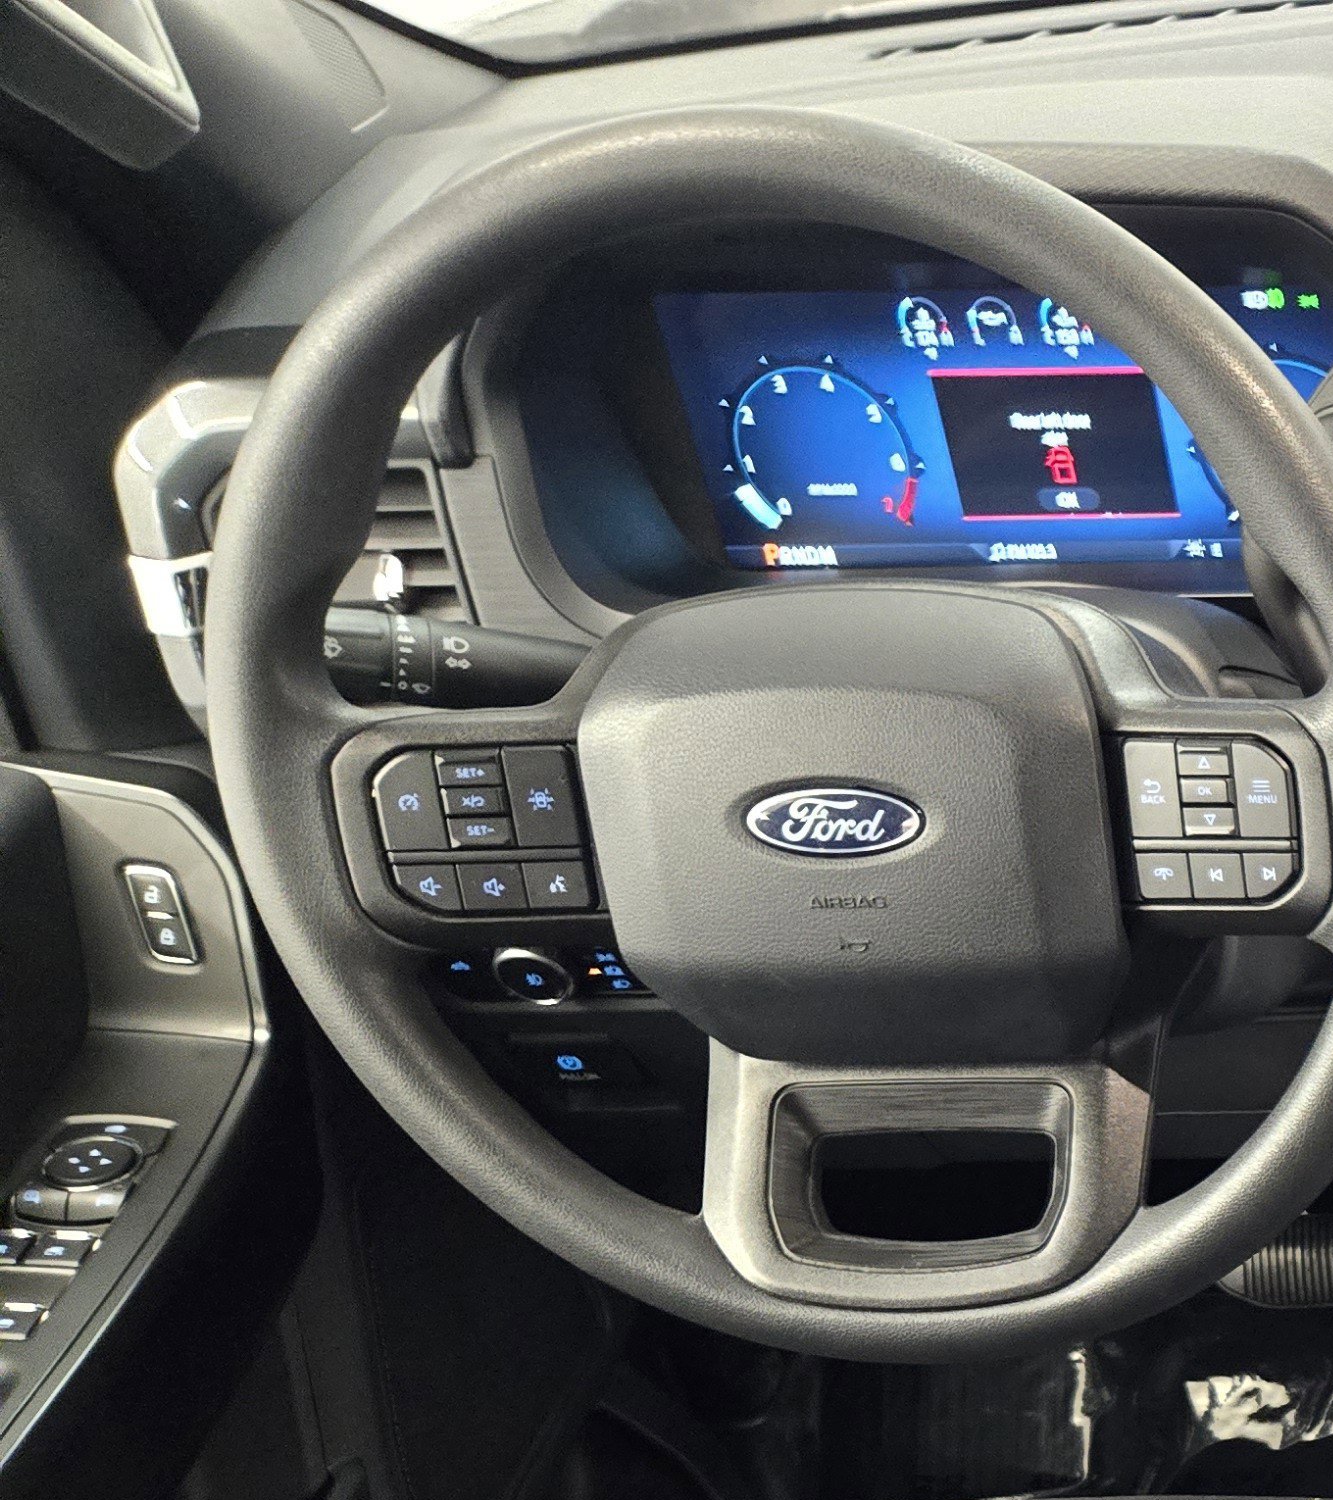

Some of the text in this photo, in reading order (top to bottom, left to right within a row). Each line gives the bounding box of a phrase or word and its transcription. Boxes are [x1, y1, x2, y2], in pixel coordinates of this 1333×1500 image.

[1197, 786, 1212, 796] OK
[1139, 794, 1166, 805] BACK
[1247, 794, 1277, 804] MENU
[781, 797, 886, 842] Ford
[810, 895, 888, 910] AIRBAG
